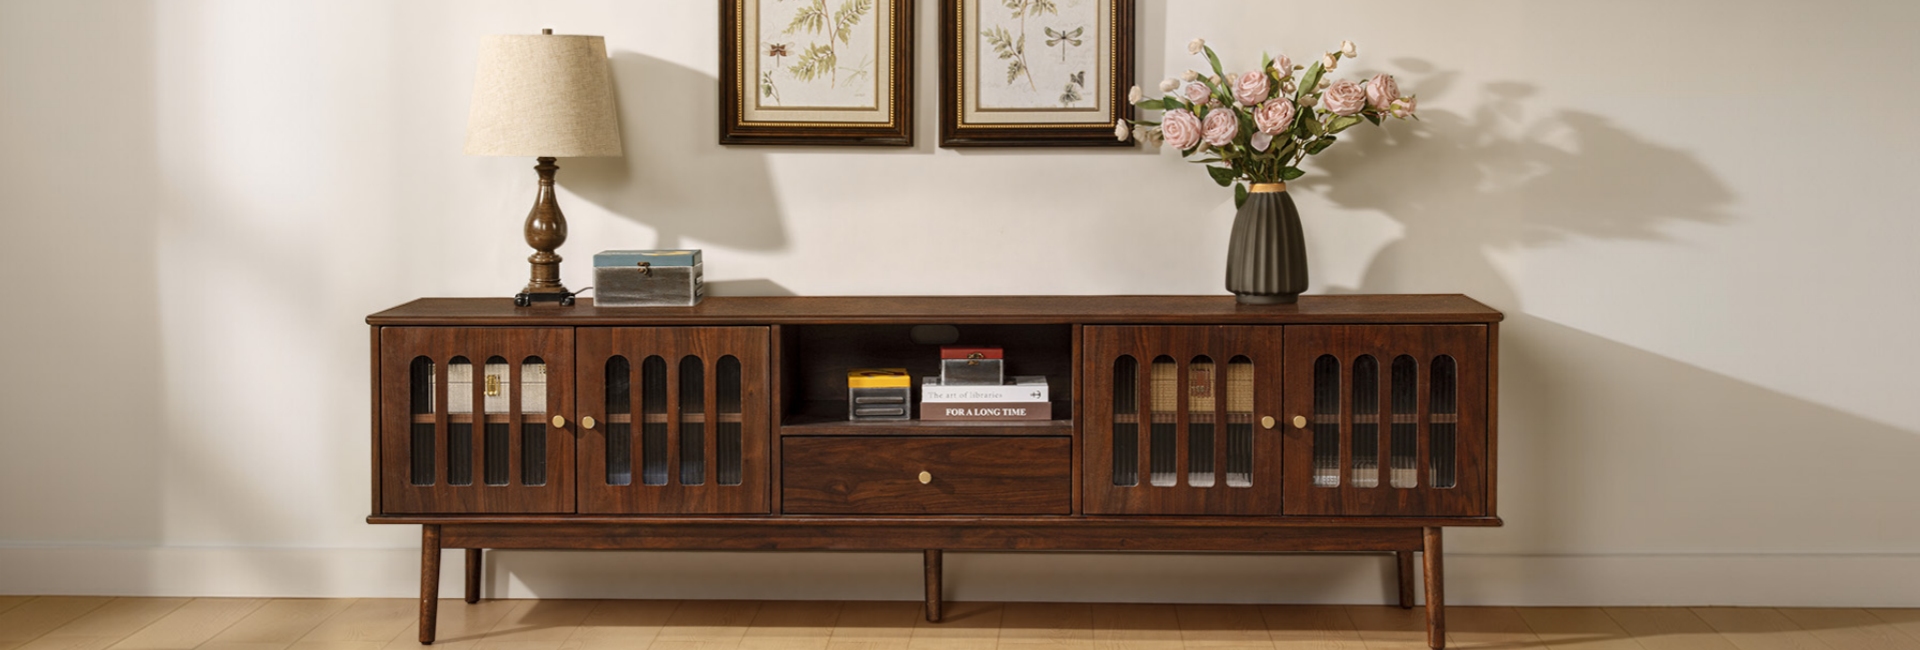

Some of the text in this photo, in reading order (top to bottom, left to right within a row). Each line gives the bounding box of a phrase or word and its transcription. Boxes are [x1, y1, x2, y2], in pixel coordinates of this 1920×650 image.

[927, 391, 943, 399] The
[959, 391, 968, 399] of
[945, 408, 1027, 416] FOR A LONG TIME
